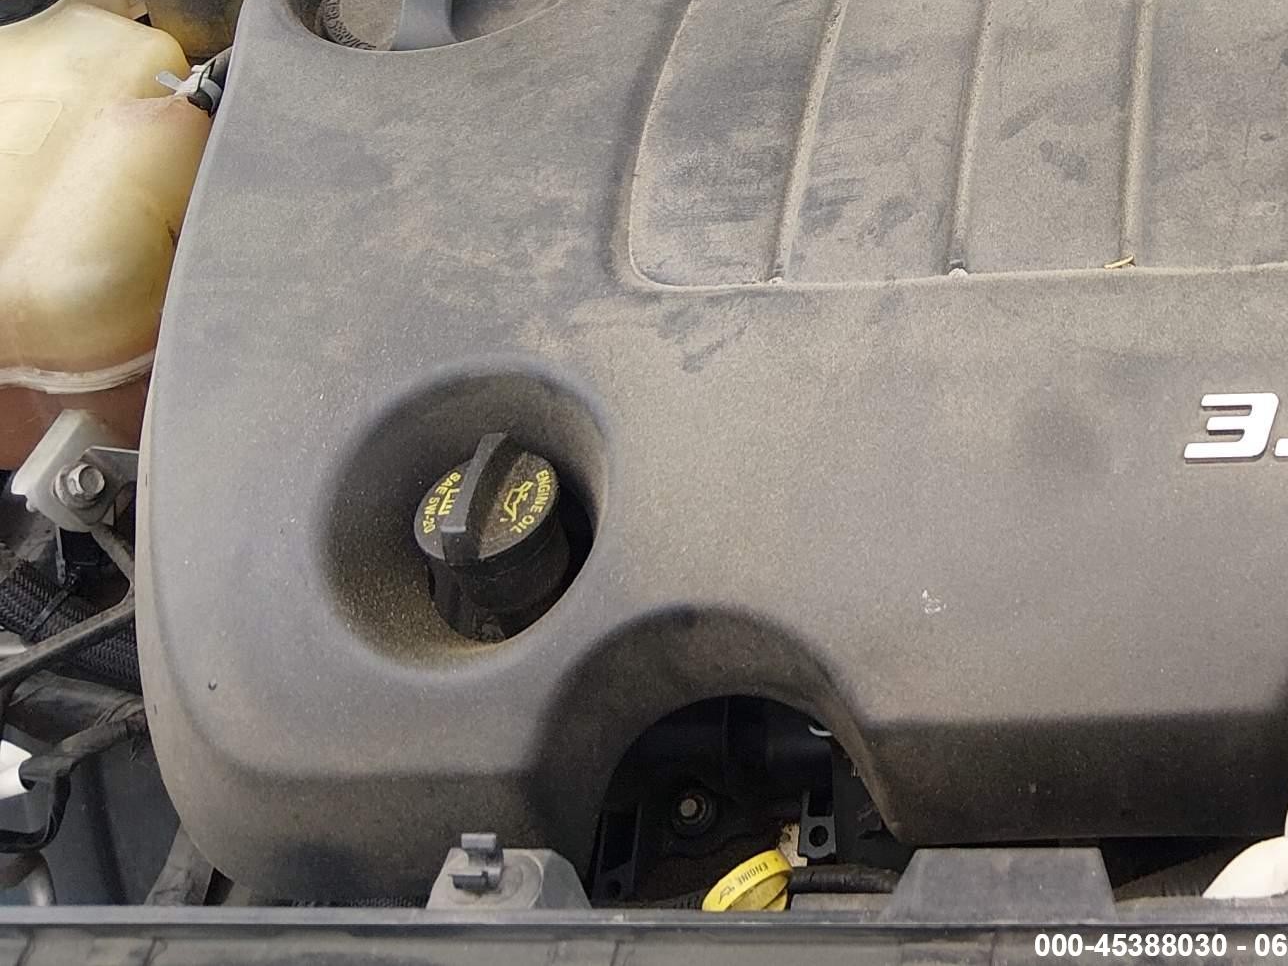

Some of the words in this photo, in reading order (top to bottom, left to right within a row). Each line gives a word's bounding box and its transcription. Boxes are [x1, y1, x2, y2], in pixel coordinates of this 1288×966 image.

[435, 471, 462, 495] SAE
[530, 469, 552, 514] ENGINE
[422, 496, 441, 534] 5W-20
[510, 514, 535, 534] OIL
